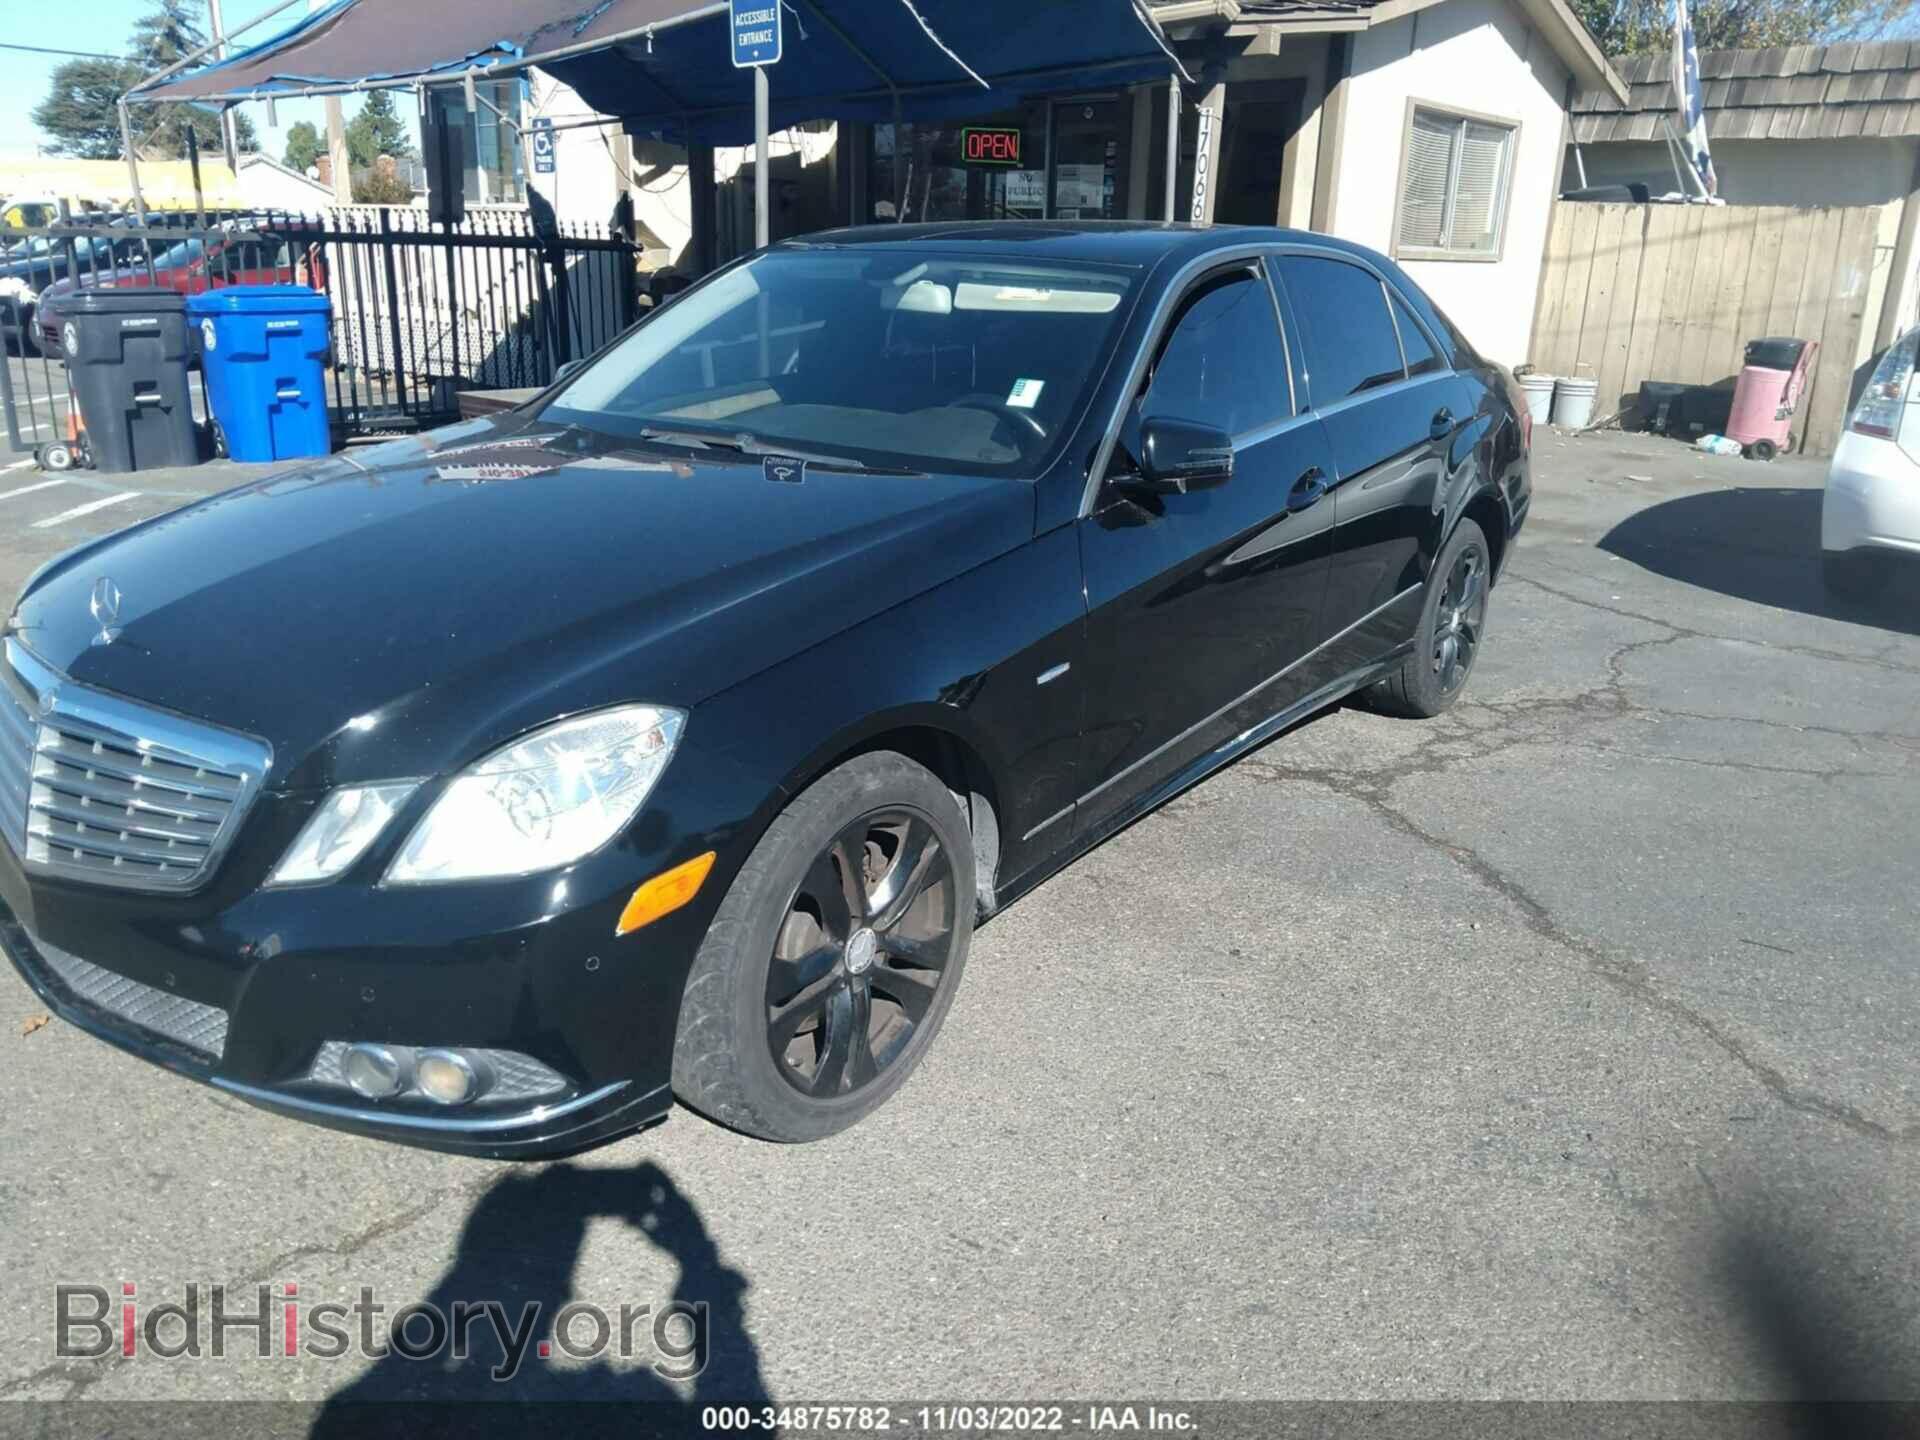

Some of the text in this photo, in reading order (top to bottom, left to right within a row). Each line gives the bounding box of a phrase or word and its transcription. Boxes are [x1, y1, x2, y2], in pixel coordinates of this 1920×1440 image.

[735, 8, 776, 26] ACCESSIBLE
[739, 29, 773, 46] ENTRANCE
[968, 134, 1017, 159] OPEN
[1193, 107, 1209, 219] 17066
